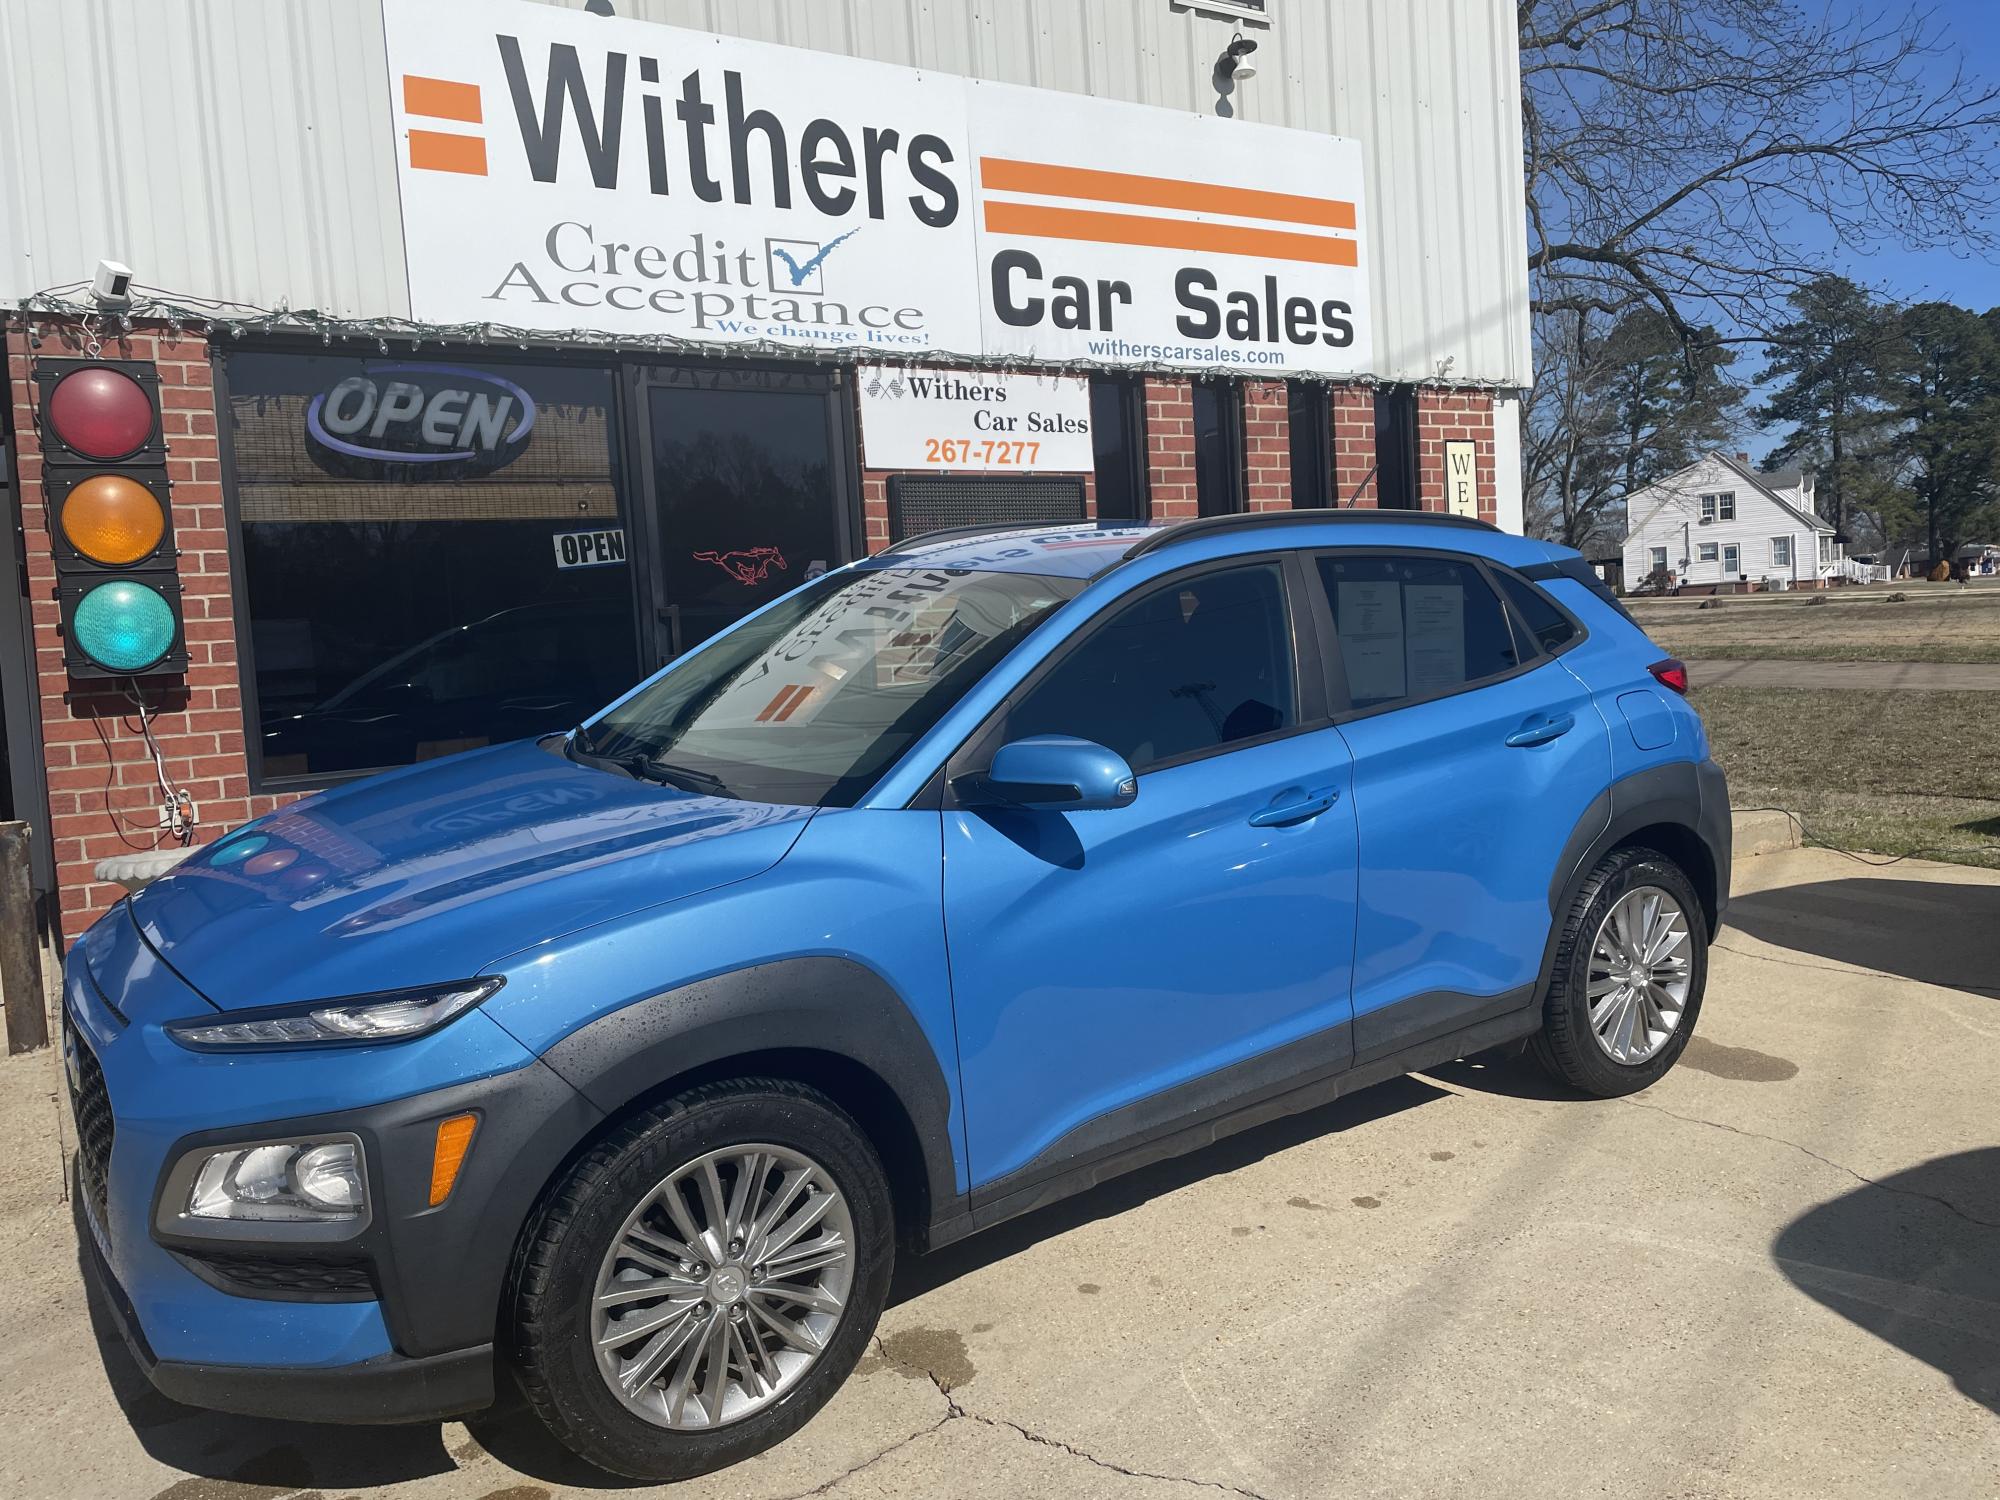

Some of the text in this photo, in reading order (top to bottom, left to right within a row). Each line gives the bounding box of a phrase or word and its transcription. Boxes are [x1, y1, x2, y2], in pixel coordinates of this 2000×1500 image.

[495, 34, 959, 228] Withers
[544, 222, 759, 288] Credit
[482, 262, 925, 330] Acceptance
[991, 249, 1355, 348] Car Sales
[716, 320, 930, 345] We change lives!
[1088, 338, 1285, 365] witherscarsales.com
[324, 376, 513, 450] OPEN
[908, 377, 1007, 402] Withers
[973, 410, 1089, 433] Car Sales
[925, 438, 1041, 464] 267-7277
[1451, 453, 1471, 516] WE
[561, 531, 626, 566] OPEN
